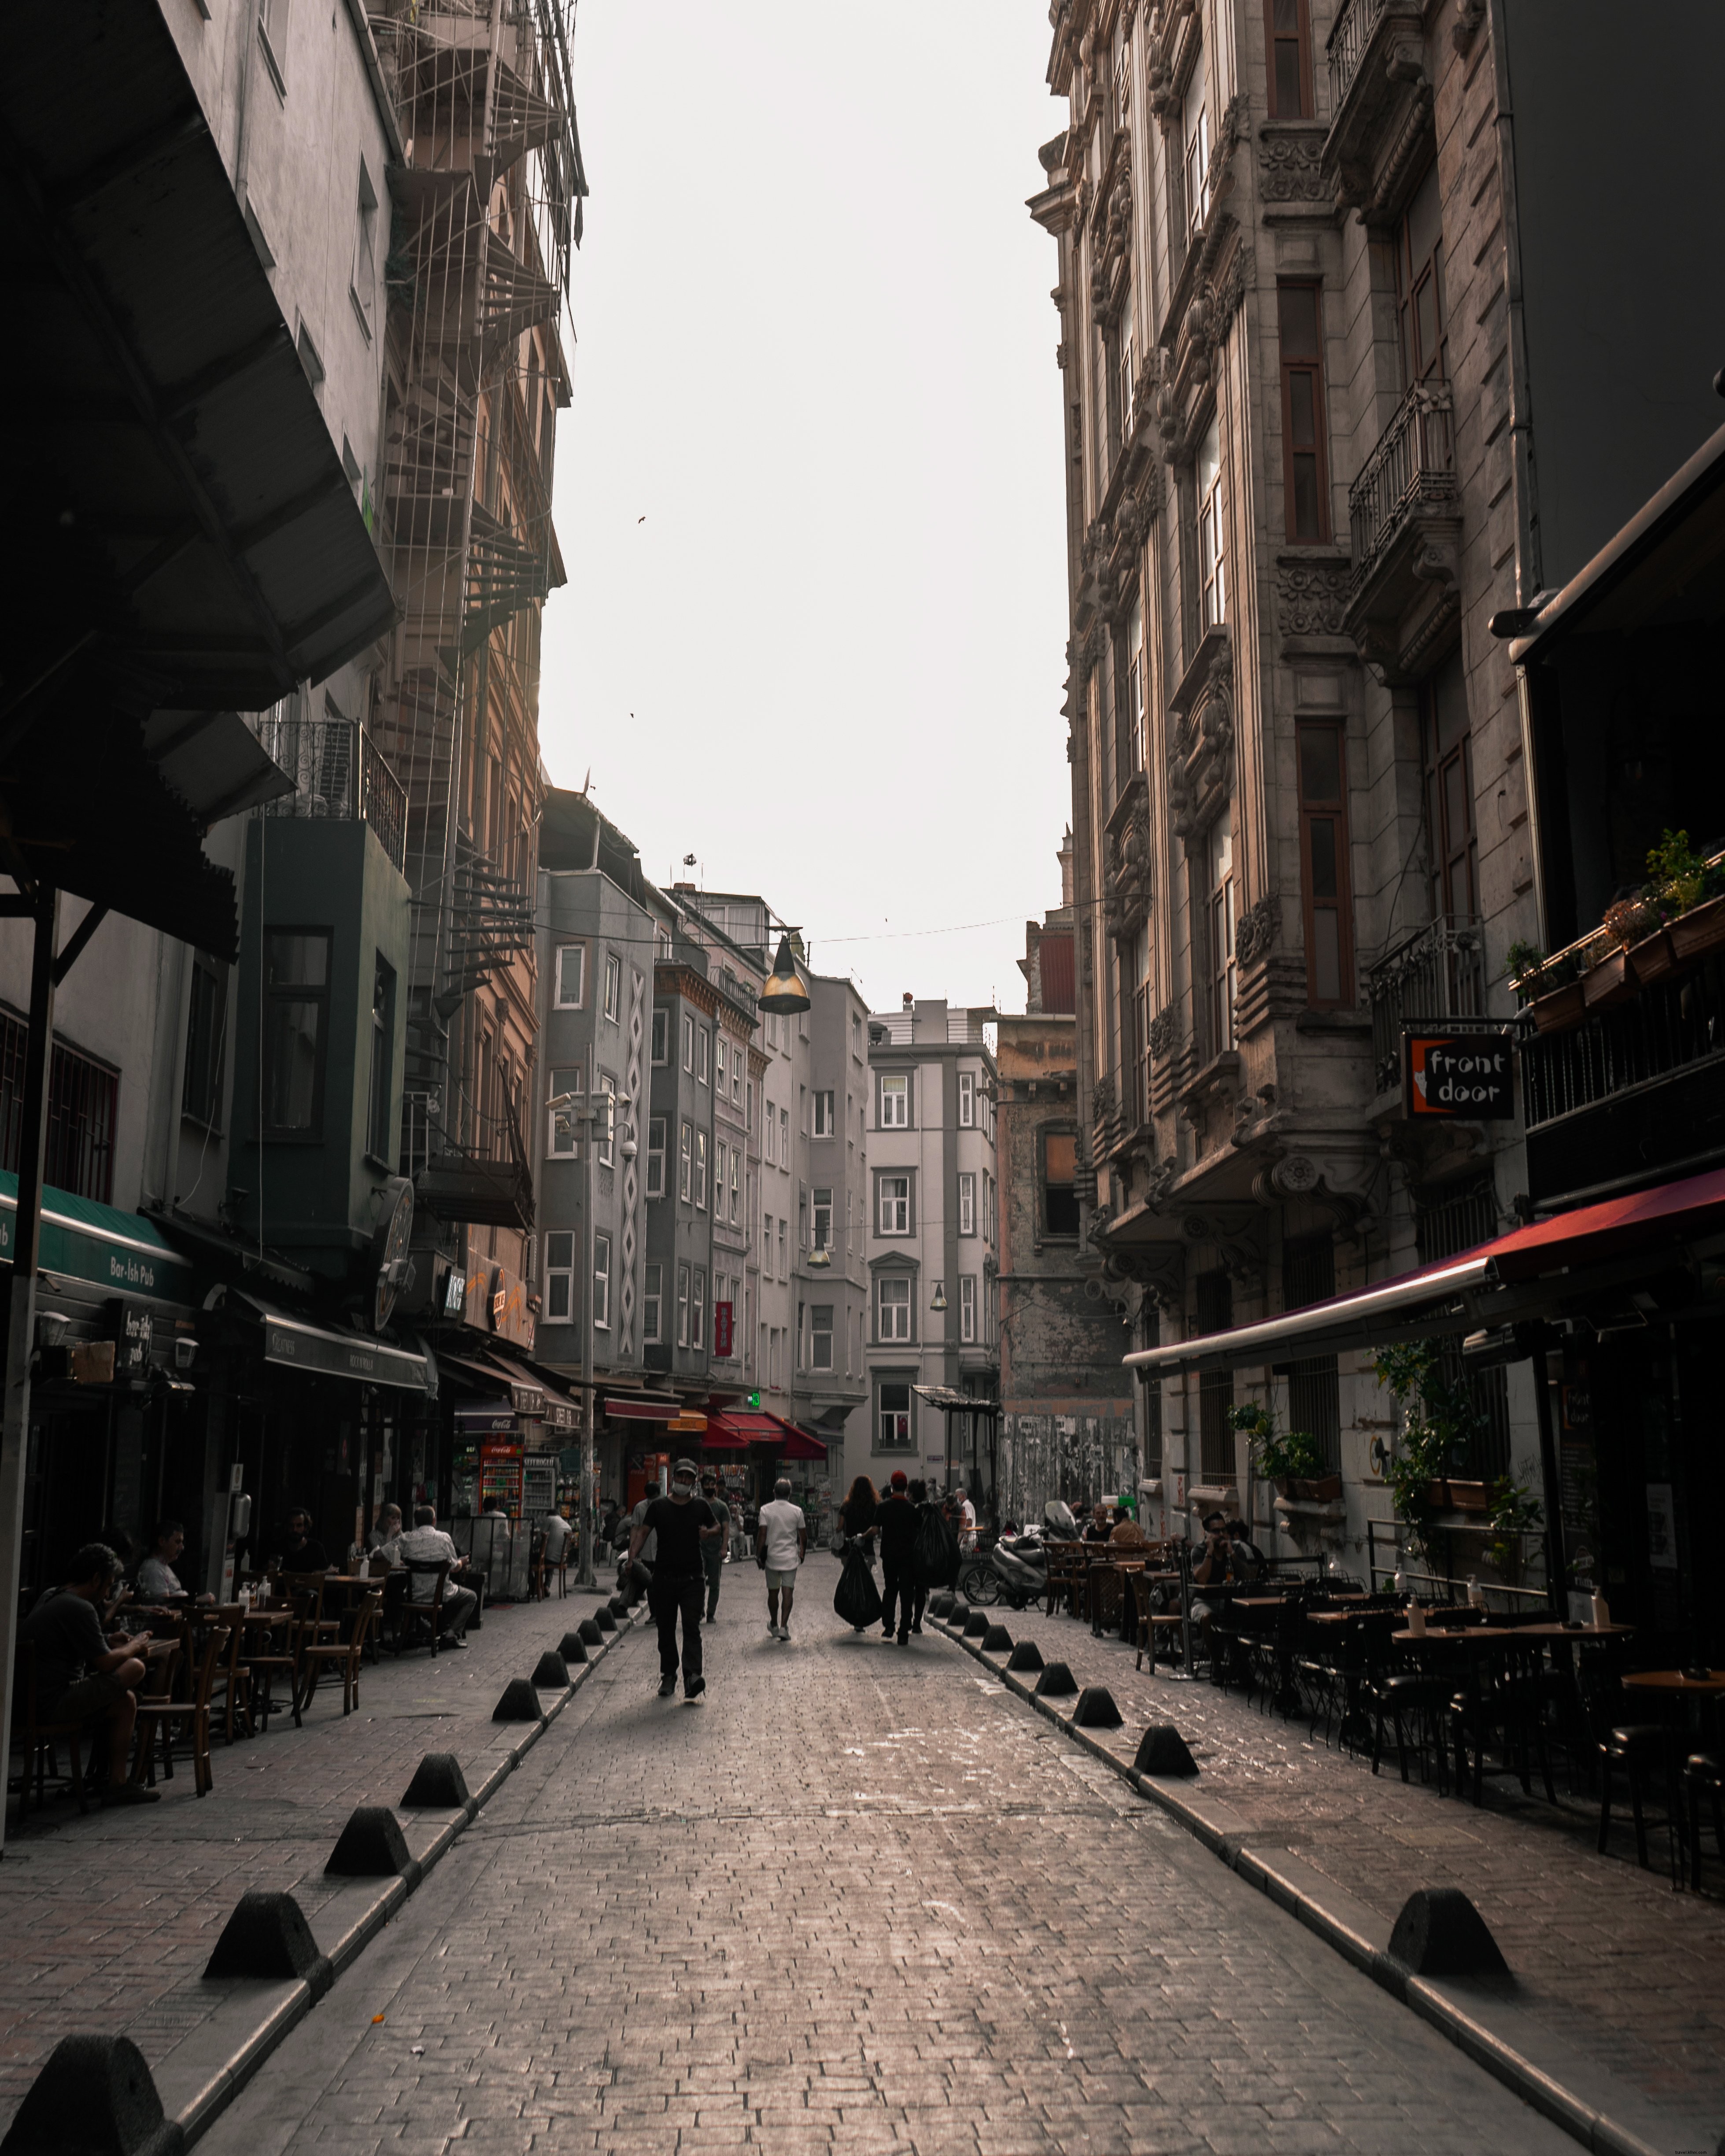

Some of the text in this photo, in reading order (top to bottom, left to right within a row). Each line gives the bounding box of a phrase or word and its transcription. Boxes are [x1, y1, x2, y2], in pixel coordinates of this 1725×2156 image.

[1430, 1050, 1506, 1074] front
[1438, 1077, 1500, 1102] door
[140, 1265, 154, 1287] Pub
[129, 1341, 142, 1365] pub
